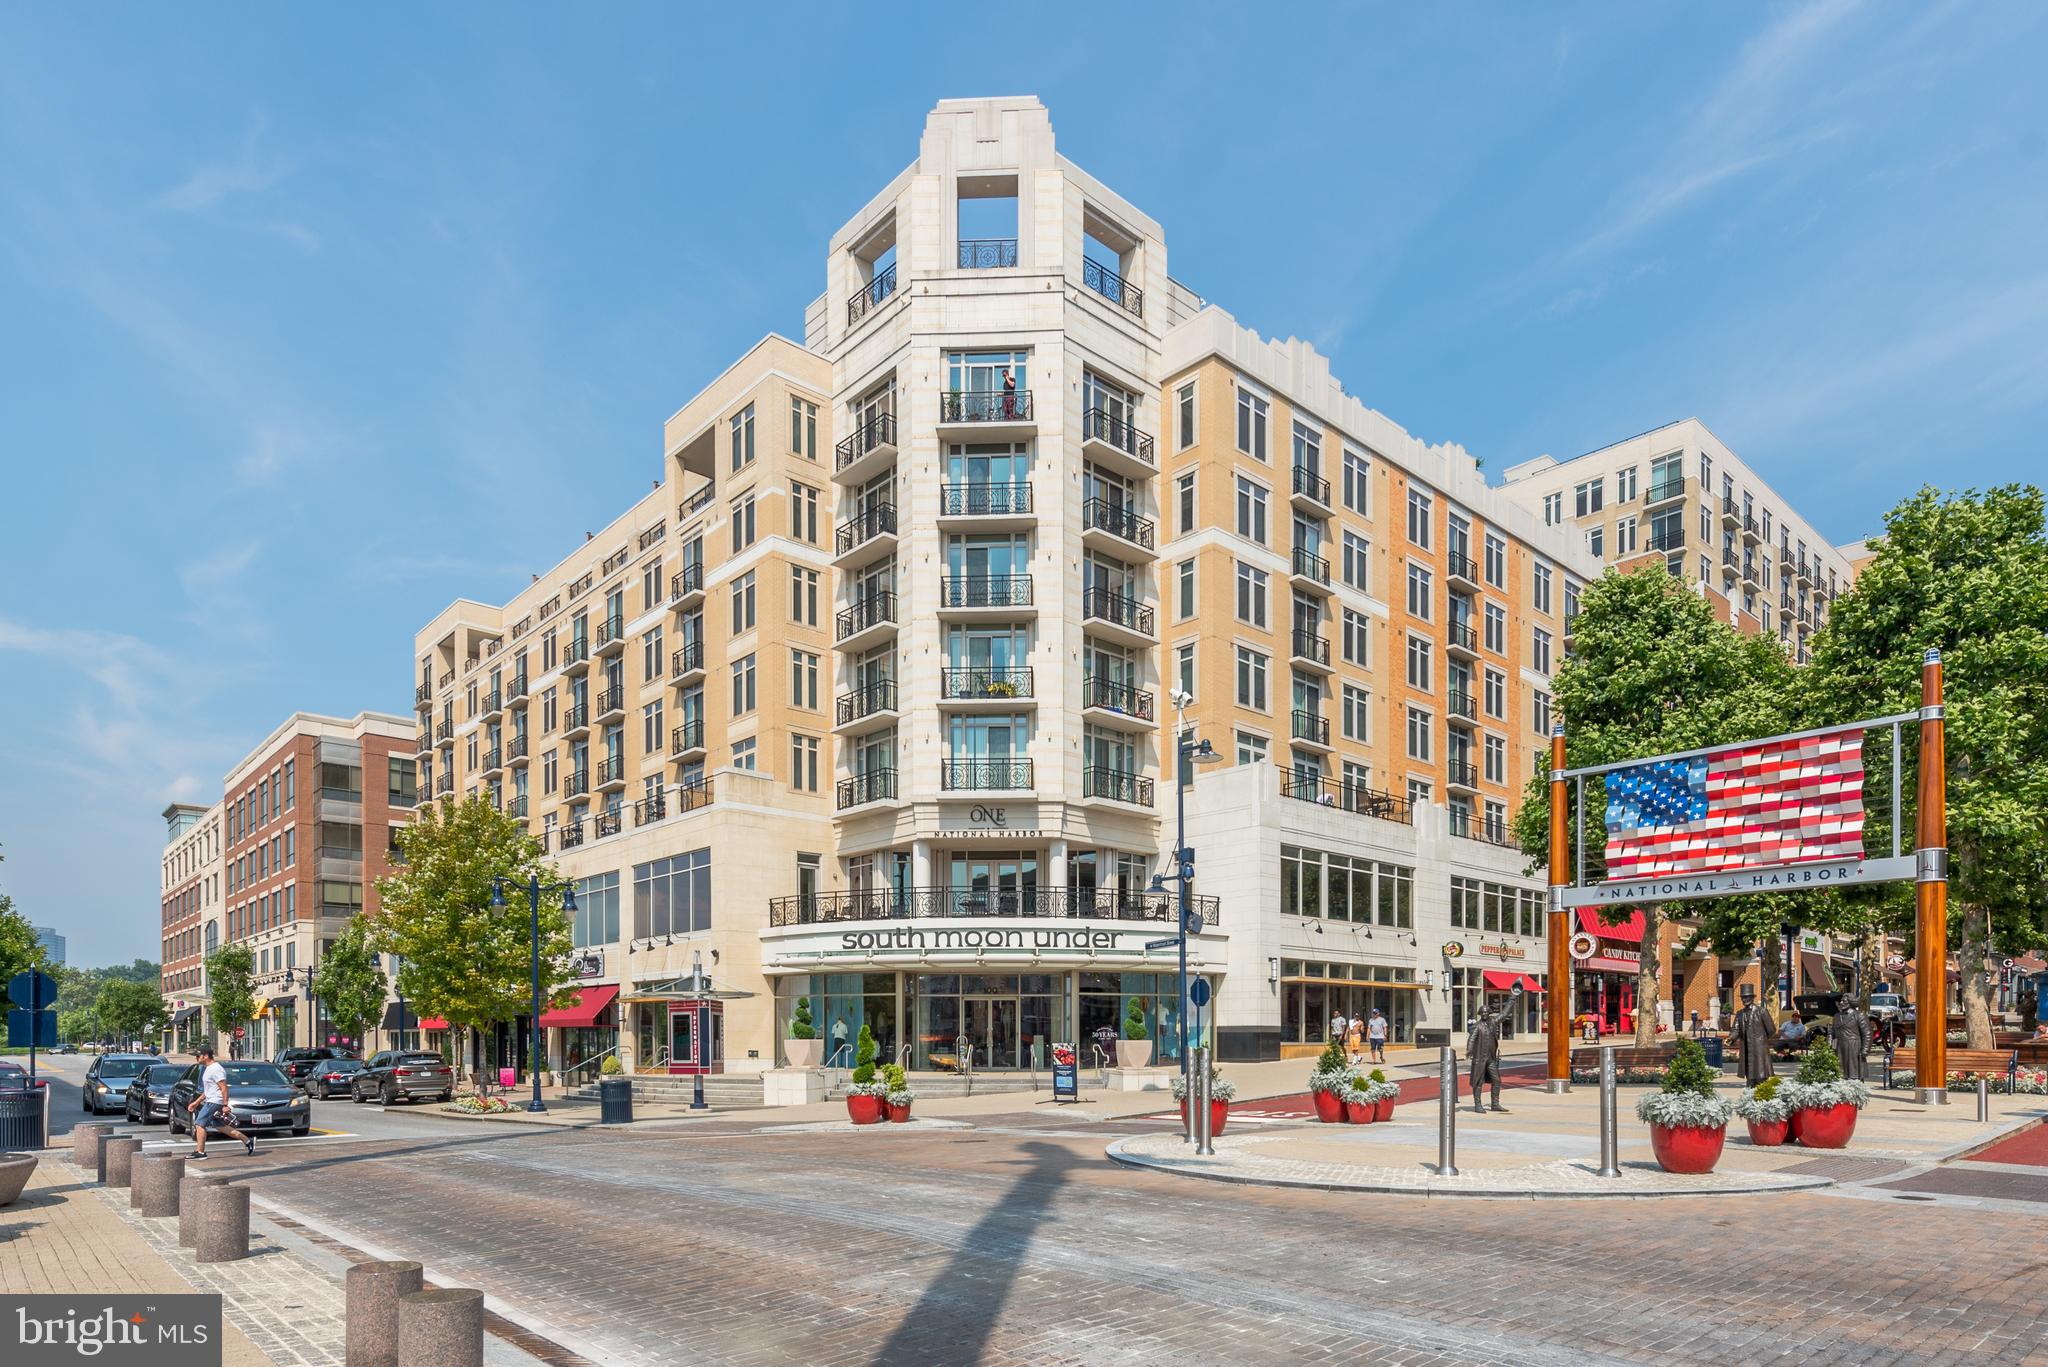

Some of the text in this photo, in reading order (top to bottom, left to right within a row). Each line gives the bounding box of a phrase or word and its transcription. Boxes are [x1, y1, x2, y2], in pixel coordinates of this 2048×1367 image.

[970, 804, 1006, 827] ONE
[1000, 830, 1043, 838] HARBOR
[1611, 868, 1848, 899] NATIONAL HARBOR
[842, 926, 1123, 949] south moon under
[1481, 945, 1525, 956] PEPPER PALACE
[1603, 948, 1622, 959] CANDY
[1624, 950, 1640, 961] KITCH
